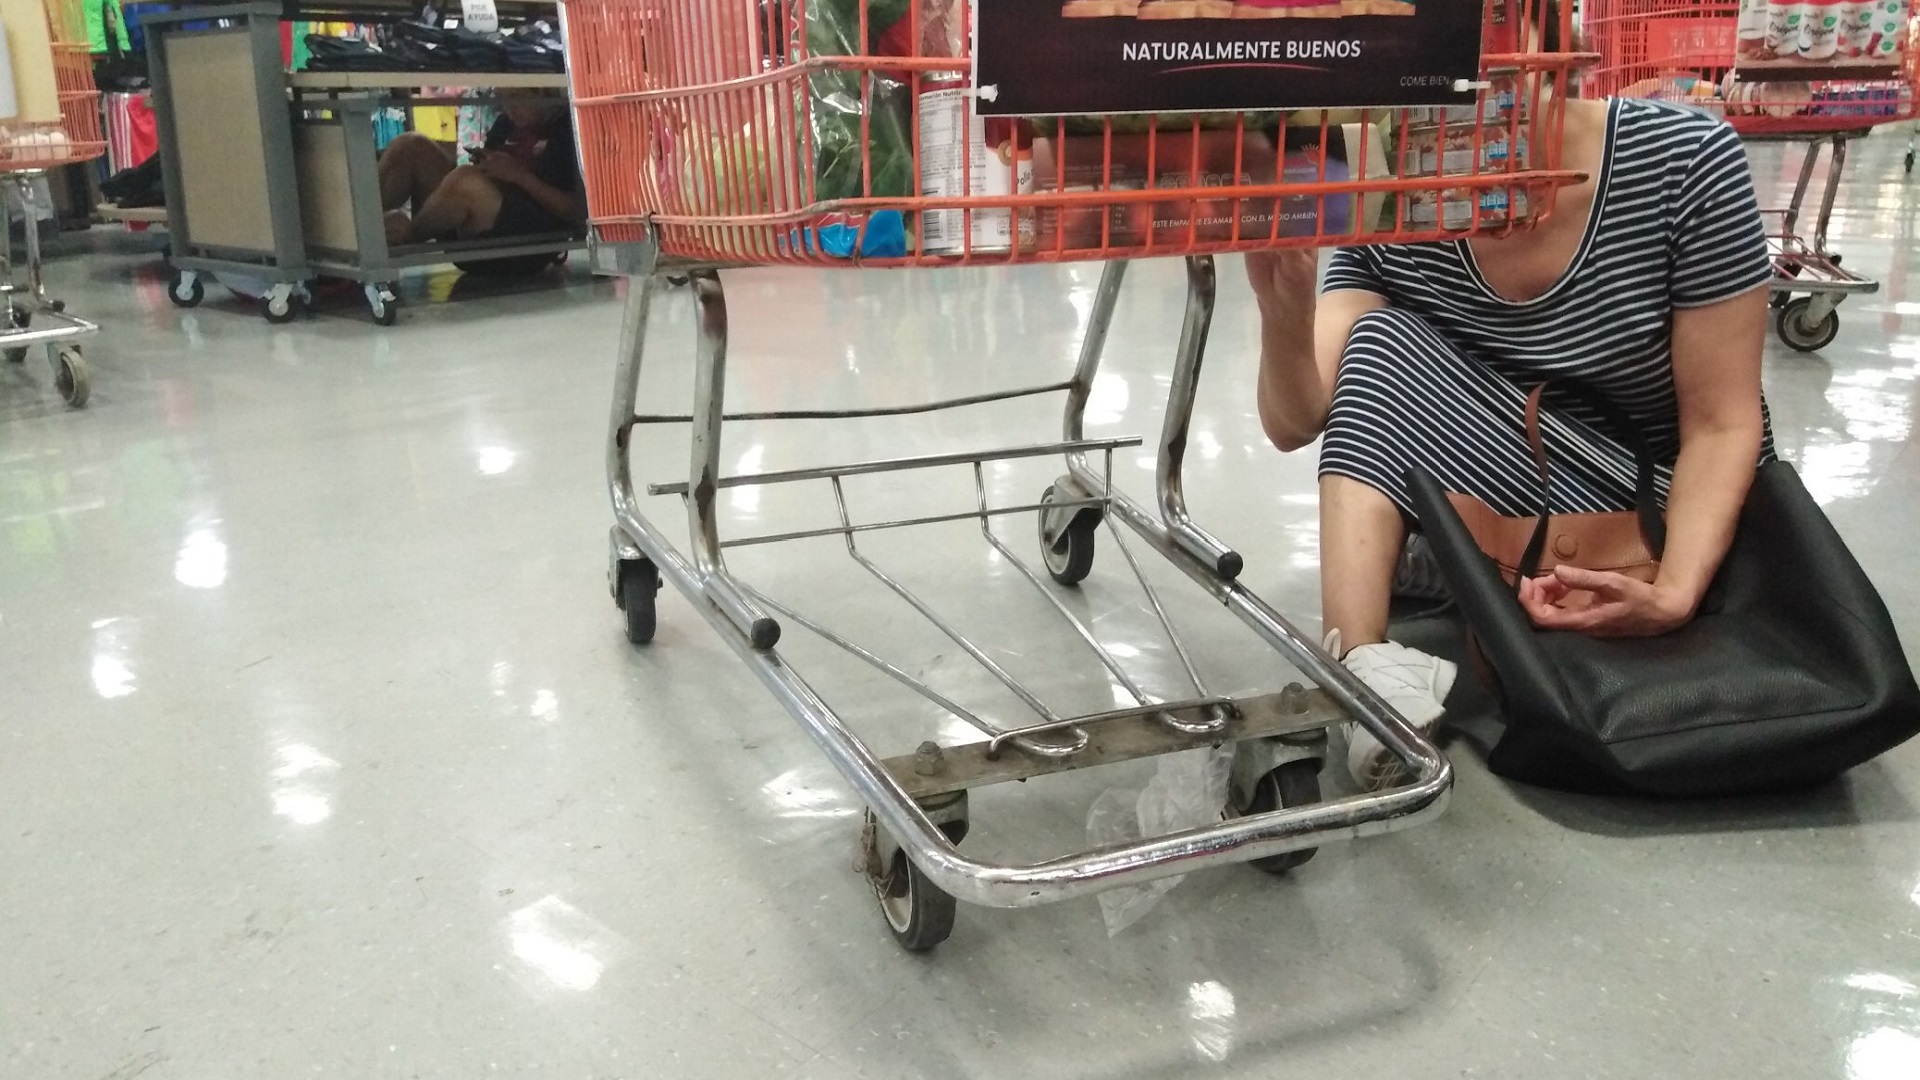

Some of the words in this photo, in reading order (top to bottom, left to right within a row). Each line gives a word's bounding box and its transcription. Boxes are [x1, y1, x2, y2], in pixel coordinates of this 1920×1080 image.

[1122, 41, 1281, 61] NATURALMENTE
[1286, 40, 1361, 59] BUENOS
[1400, 76, 1427, 87] COME
[1152, 220, 1168, 228] ESTE
[1203, 217, 1213, 225] ES
[1241, 215, 1258, 223] CON
[1258, 214, 1266, 222] EL
